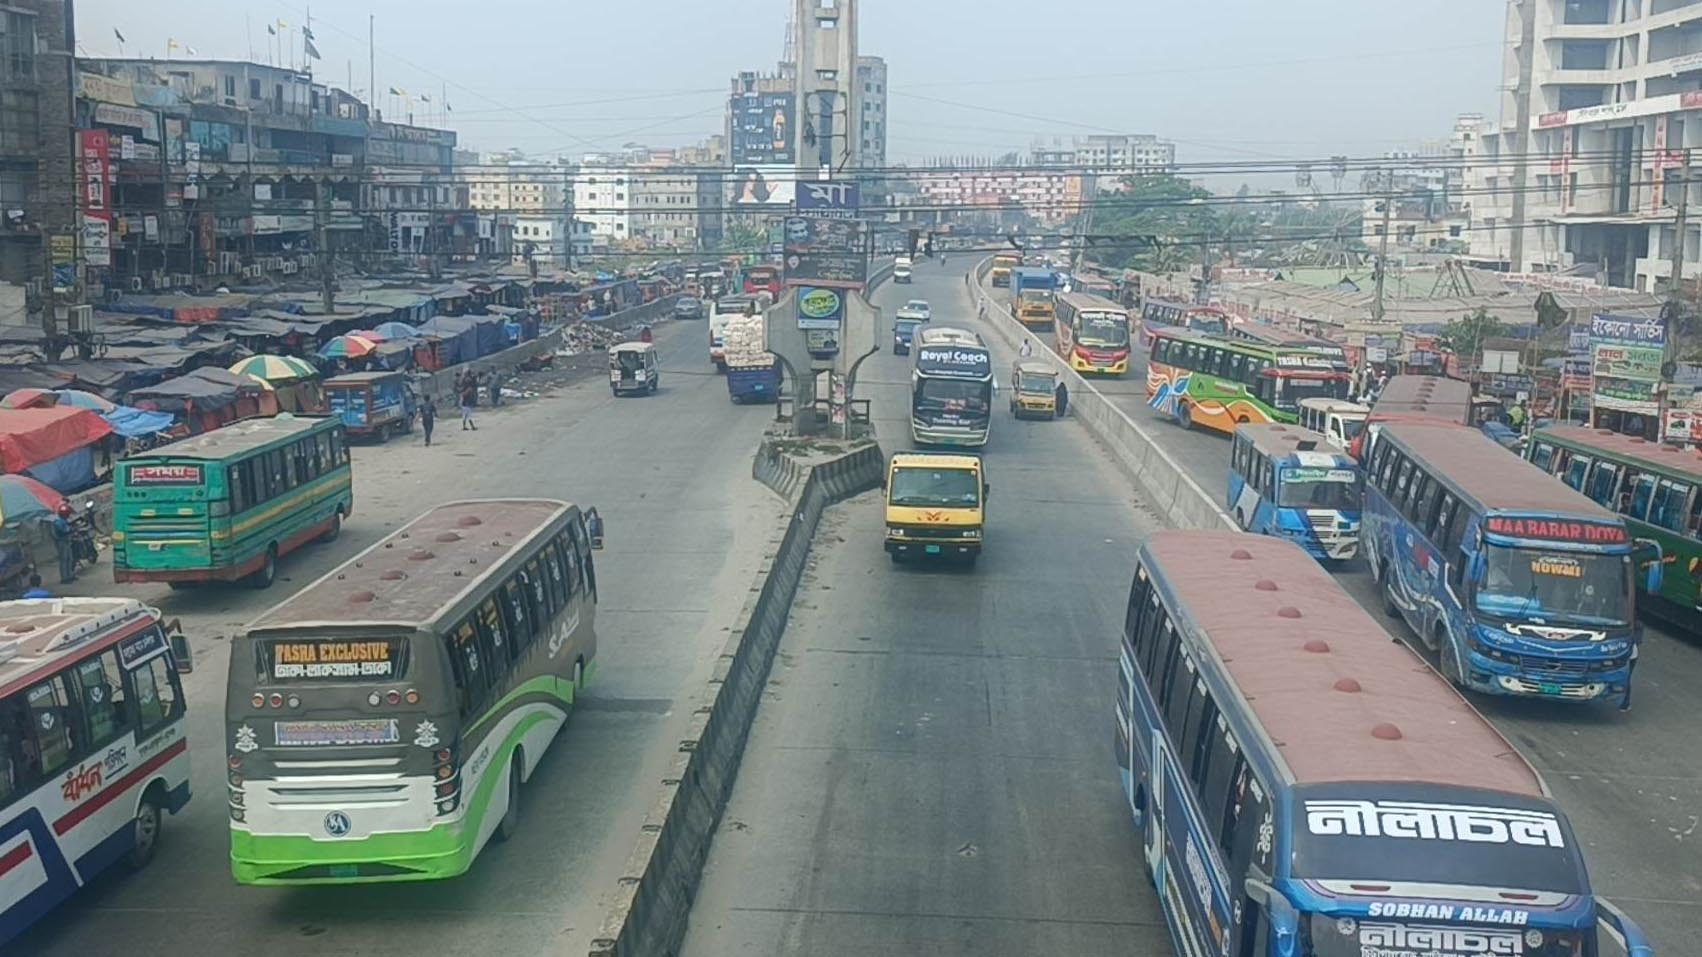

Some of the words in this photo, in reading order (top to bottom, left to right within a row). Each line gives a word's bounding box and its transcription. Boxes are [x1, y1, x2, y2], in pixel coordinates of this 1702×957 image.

[1591, 315, 1631, 337] ইকোনো
[1633, 319, 1664, 342] সার্ভিস
[921, 350, 952, 362] Royal
[953, 351, 988, 363] Coach
[1488, 518, 1524, 535] MAA
[319, 642, 388, 661] EXCLUSIVE
[1304, 800, 1565, 848] নীলাচল
[1367, 902, 1454, 921] SOBHAN
[1458, 905, 1529, 925] ALLAH
[1359, 920, 1524, 954] নীলাচল
